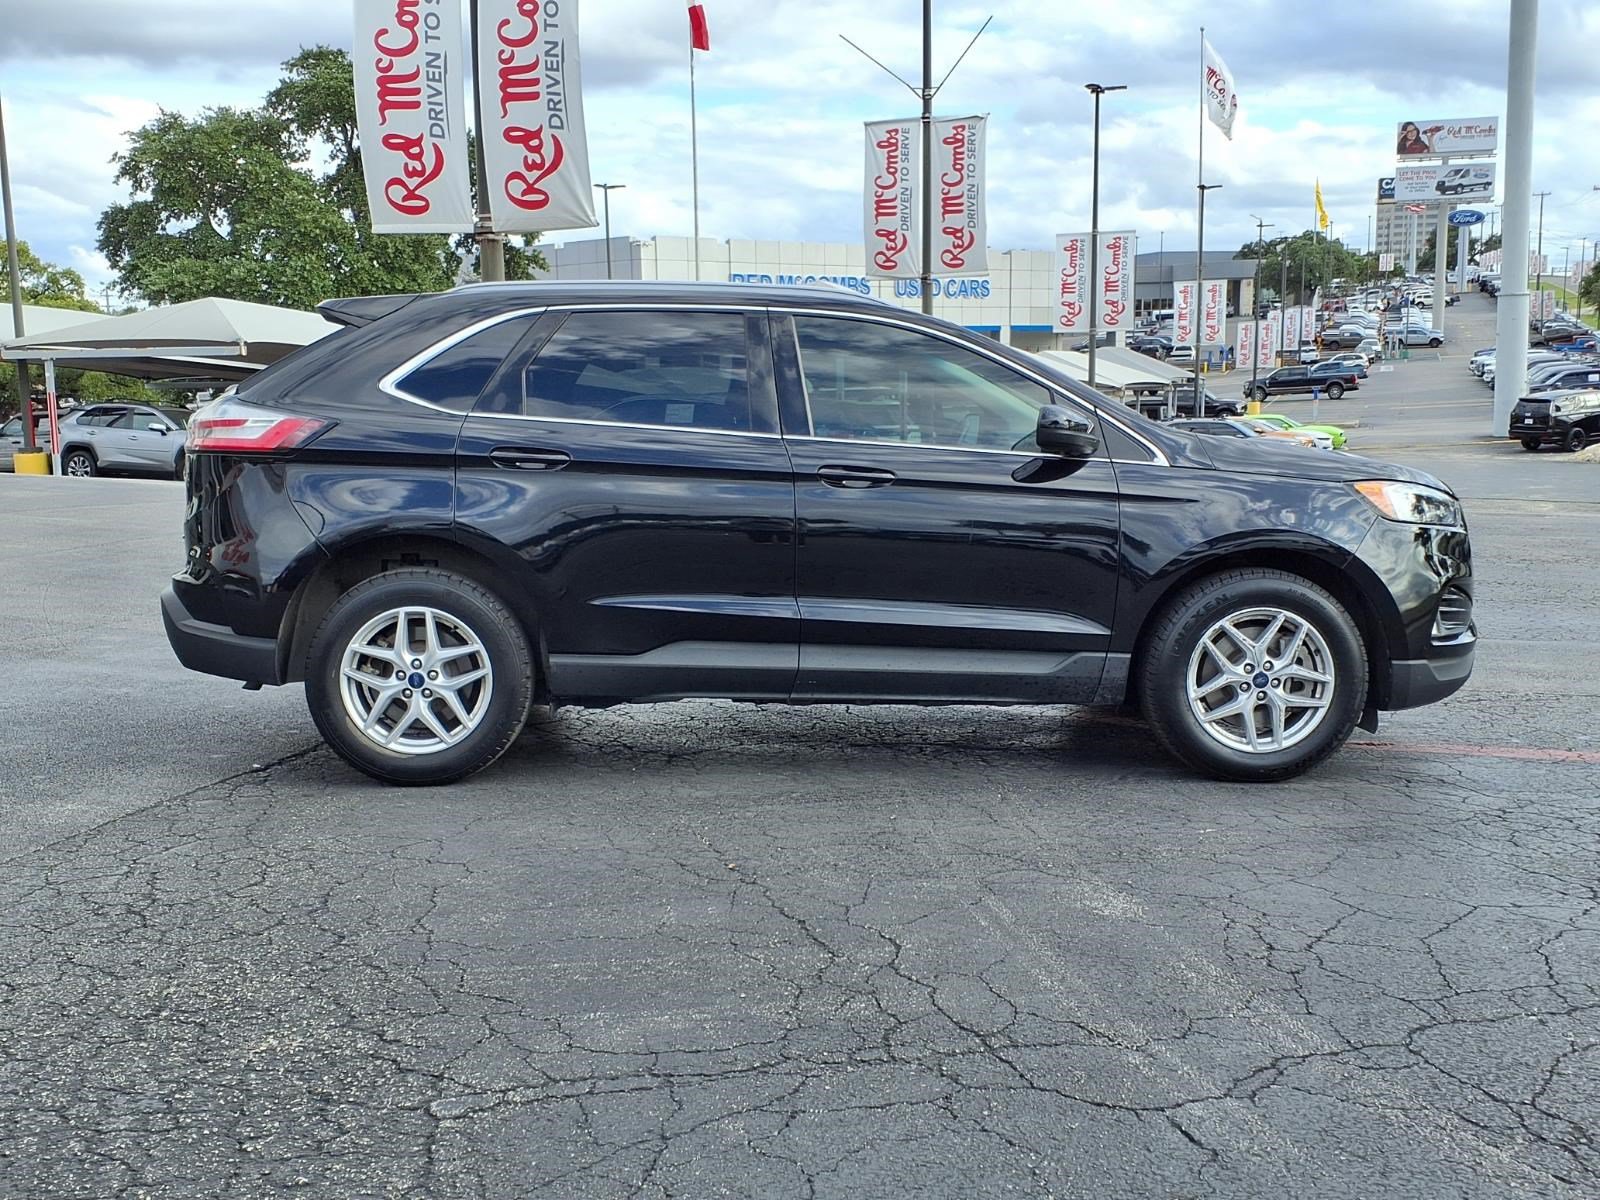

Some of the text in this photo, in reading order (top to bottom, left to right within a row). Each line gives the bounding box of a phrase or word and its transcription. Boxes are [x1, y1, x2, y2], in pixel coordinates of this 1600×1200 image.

[424, 12, 441, 44] TO
[543, 0, 565, 130] DRIVEN TO
[424, 51, 446, 140] DRIVEN
[382, 132, 444, 216] Red
[503, 124, 564, 210] Red
[873, 127, 908, 271] Red McCombs
[900, 127, 911, 232] DRIVEN TO SERVE
[940, 124, 975, 269] Red McCombs
[967, 123, 977, 229] DRIVEN TO SERVE
[896, 279, 941, 297] USD
[946, 279, 990, 298] CARS
[1060, 239, 1082, 327] Red McCombs
[1078, 264, 1085, 273] TO
[1103, 236, 1125, 326] Red McCombs
[1121, 260, 1128, 271] TO
[1176, 325, 1191, 342] Red
[1205, 324, 1220, 341] Red
